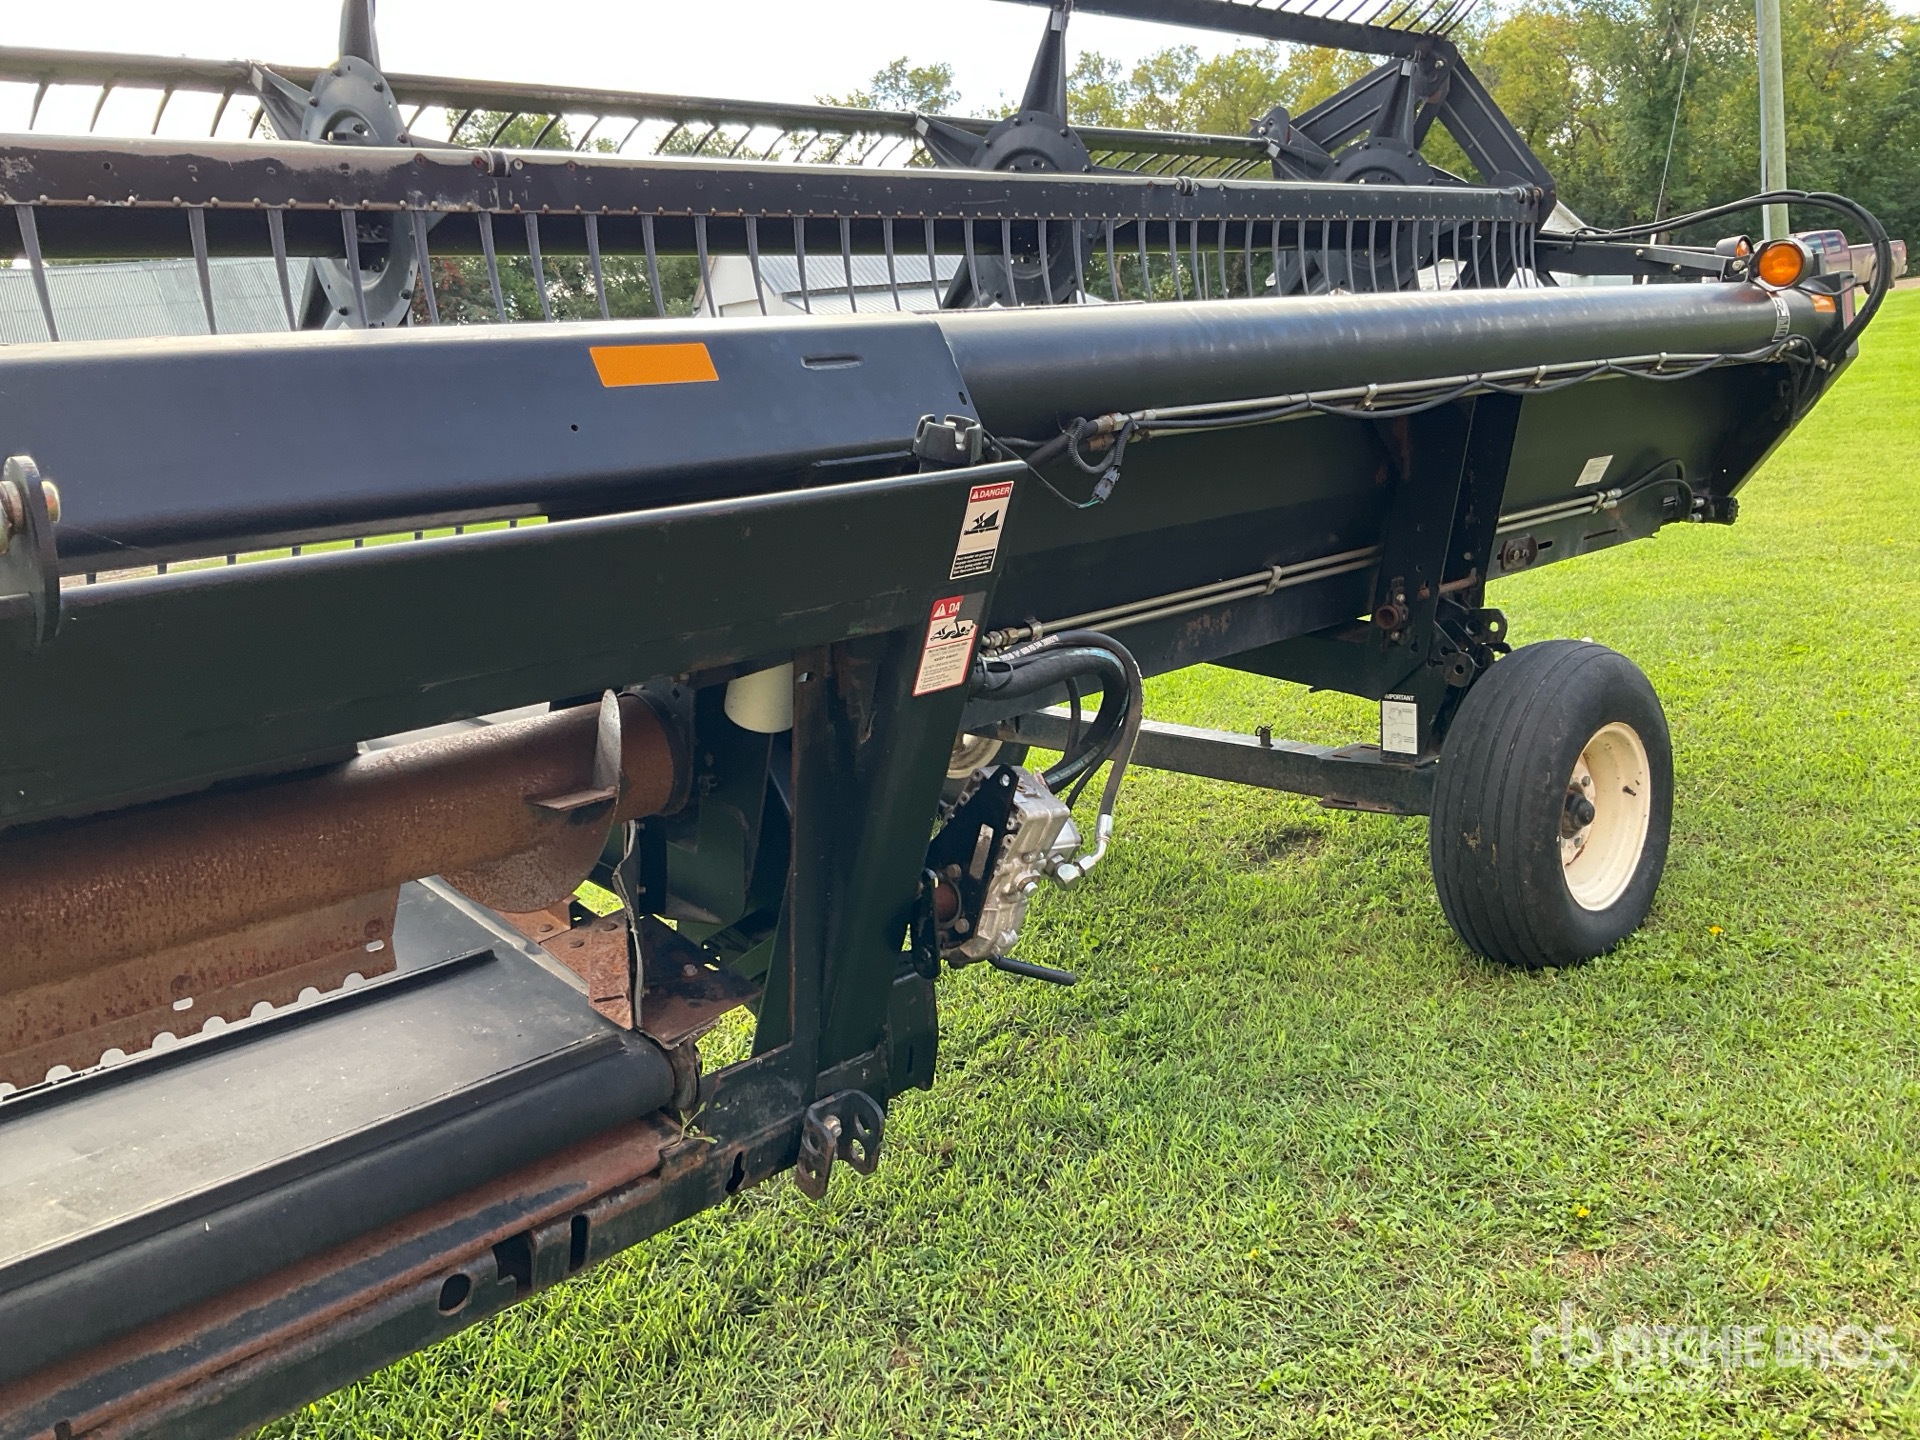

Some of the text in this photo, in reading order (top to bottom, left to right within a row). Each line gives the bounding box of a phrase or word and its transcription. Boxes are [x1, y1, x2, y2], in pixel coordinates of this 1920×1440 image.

[979, 486, 1011, 499] DANGER
[948, 601, 963, 614] DA
[1384, 693, 1415, 702] IMPORTANT
